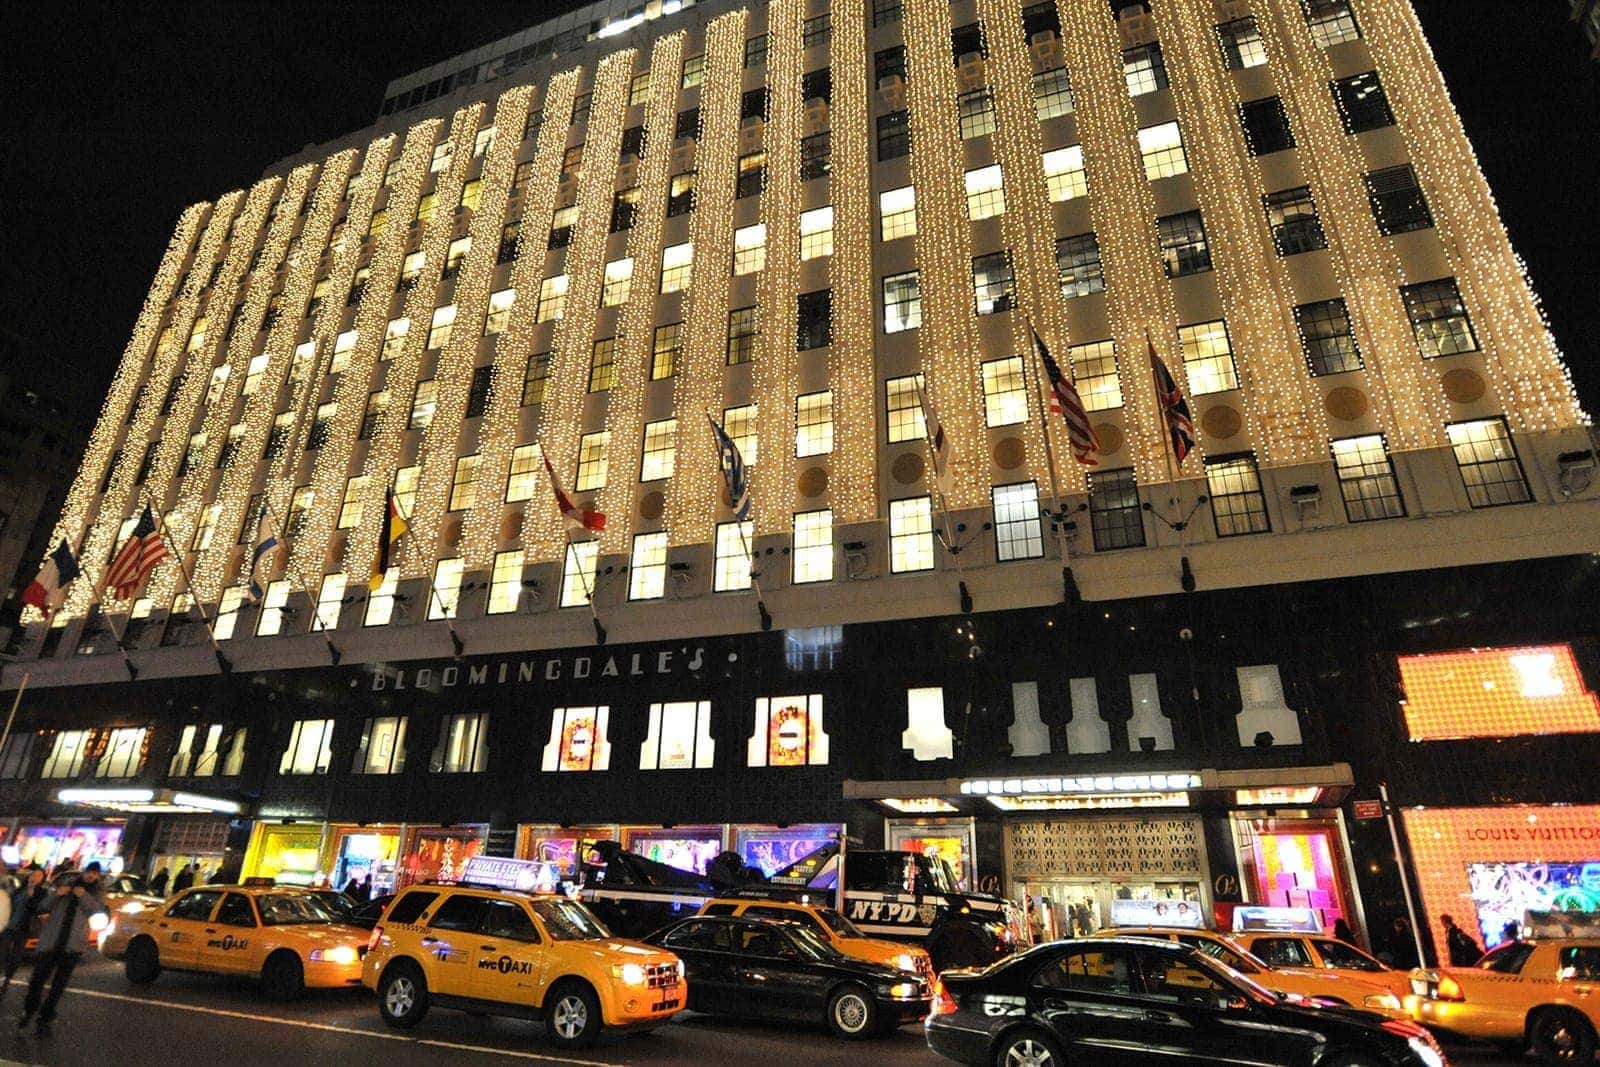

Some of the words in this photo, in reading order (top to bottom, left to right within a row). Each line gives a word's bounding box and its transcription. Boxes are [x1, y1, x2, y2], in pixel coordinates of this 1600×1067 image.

[372, 647, 704, 691] BLOOMINGDALE'S
[1466, 828, 1520, 840] LOUIS
[850, 901, 917, 922] NYPD
